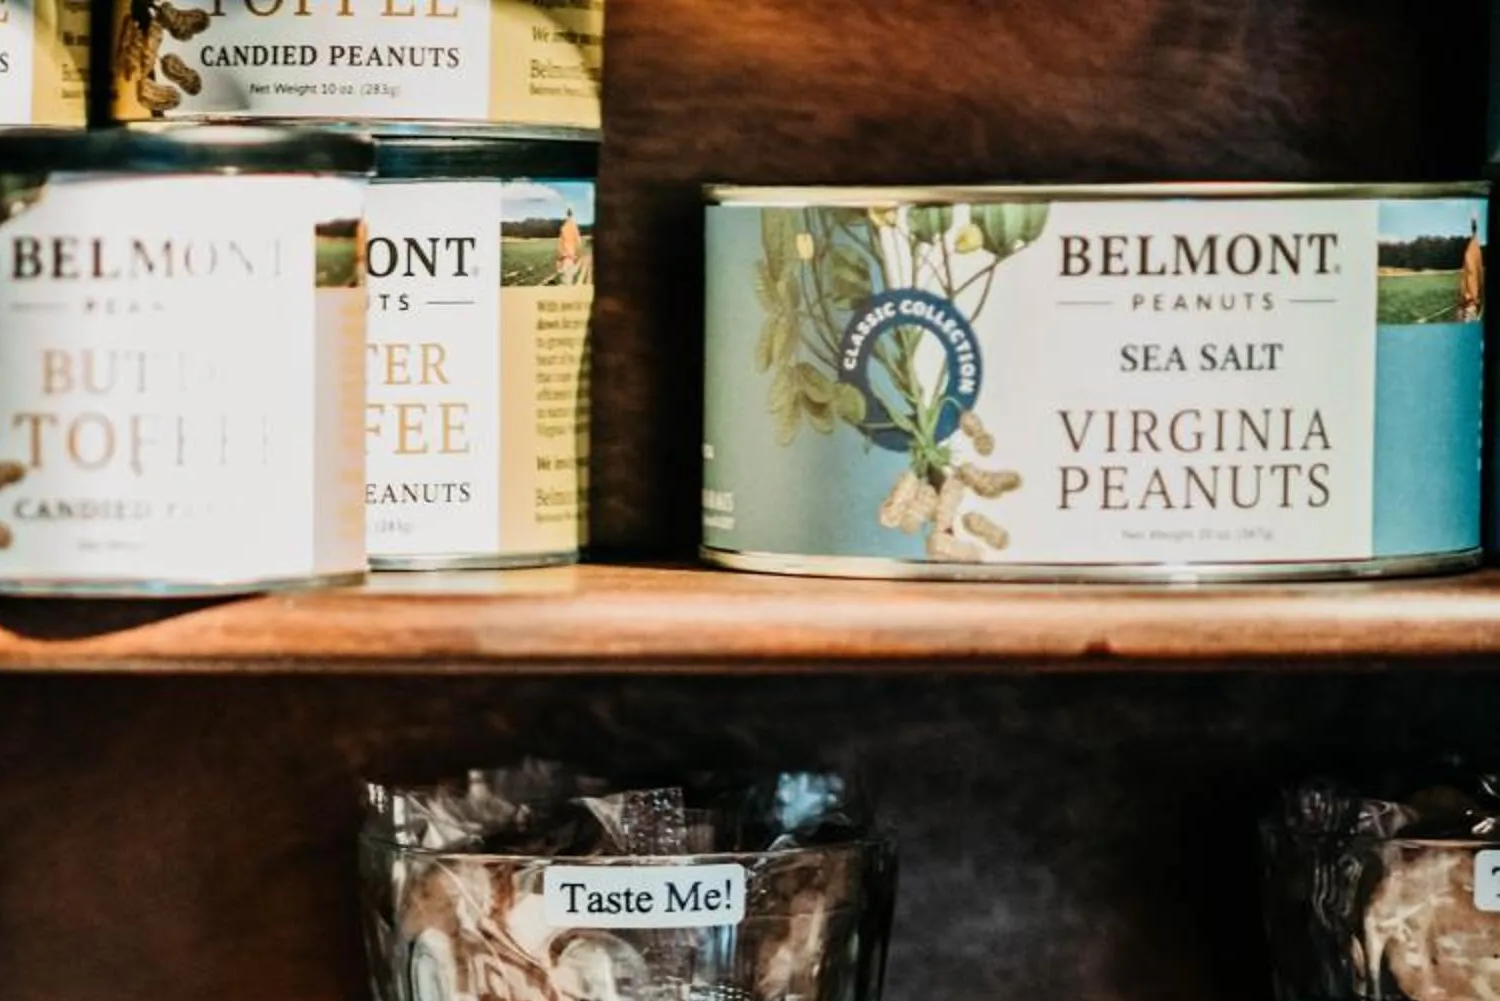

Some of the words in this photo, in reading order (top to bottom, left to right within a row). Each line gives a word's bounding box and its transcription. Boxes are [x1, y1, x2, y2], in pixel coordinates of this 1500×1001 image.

[201, 45, 317, 67] CANDIED
[330, 46, 460, 69] PEANUTS
[321, 83, 337, 95] 10
[1058, 233, 1338, 278] BELMONT
[1130, 292, 1277, 312] PEANUTS
[843, 301, 897, 370] CLASSIC
[899, 299, 976, 394] COLLECTION
[1119, 343, 1188, 373] SEA
[1199, 343, 1284, 371] SALT
[1058, 408, 1333, 453] VIRGINIA
[365, 483, 472, 504] EANUTS
[1057, 462, 1332, 510] PEANUTS
[559, 882, 654, 916] Taste
[663, 879, 734, 913] Me!
